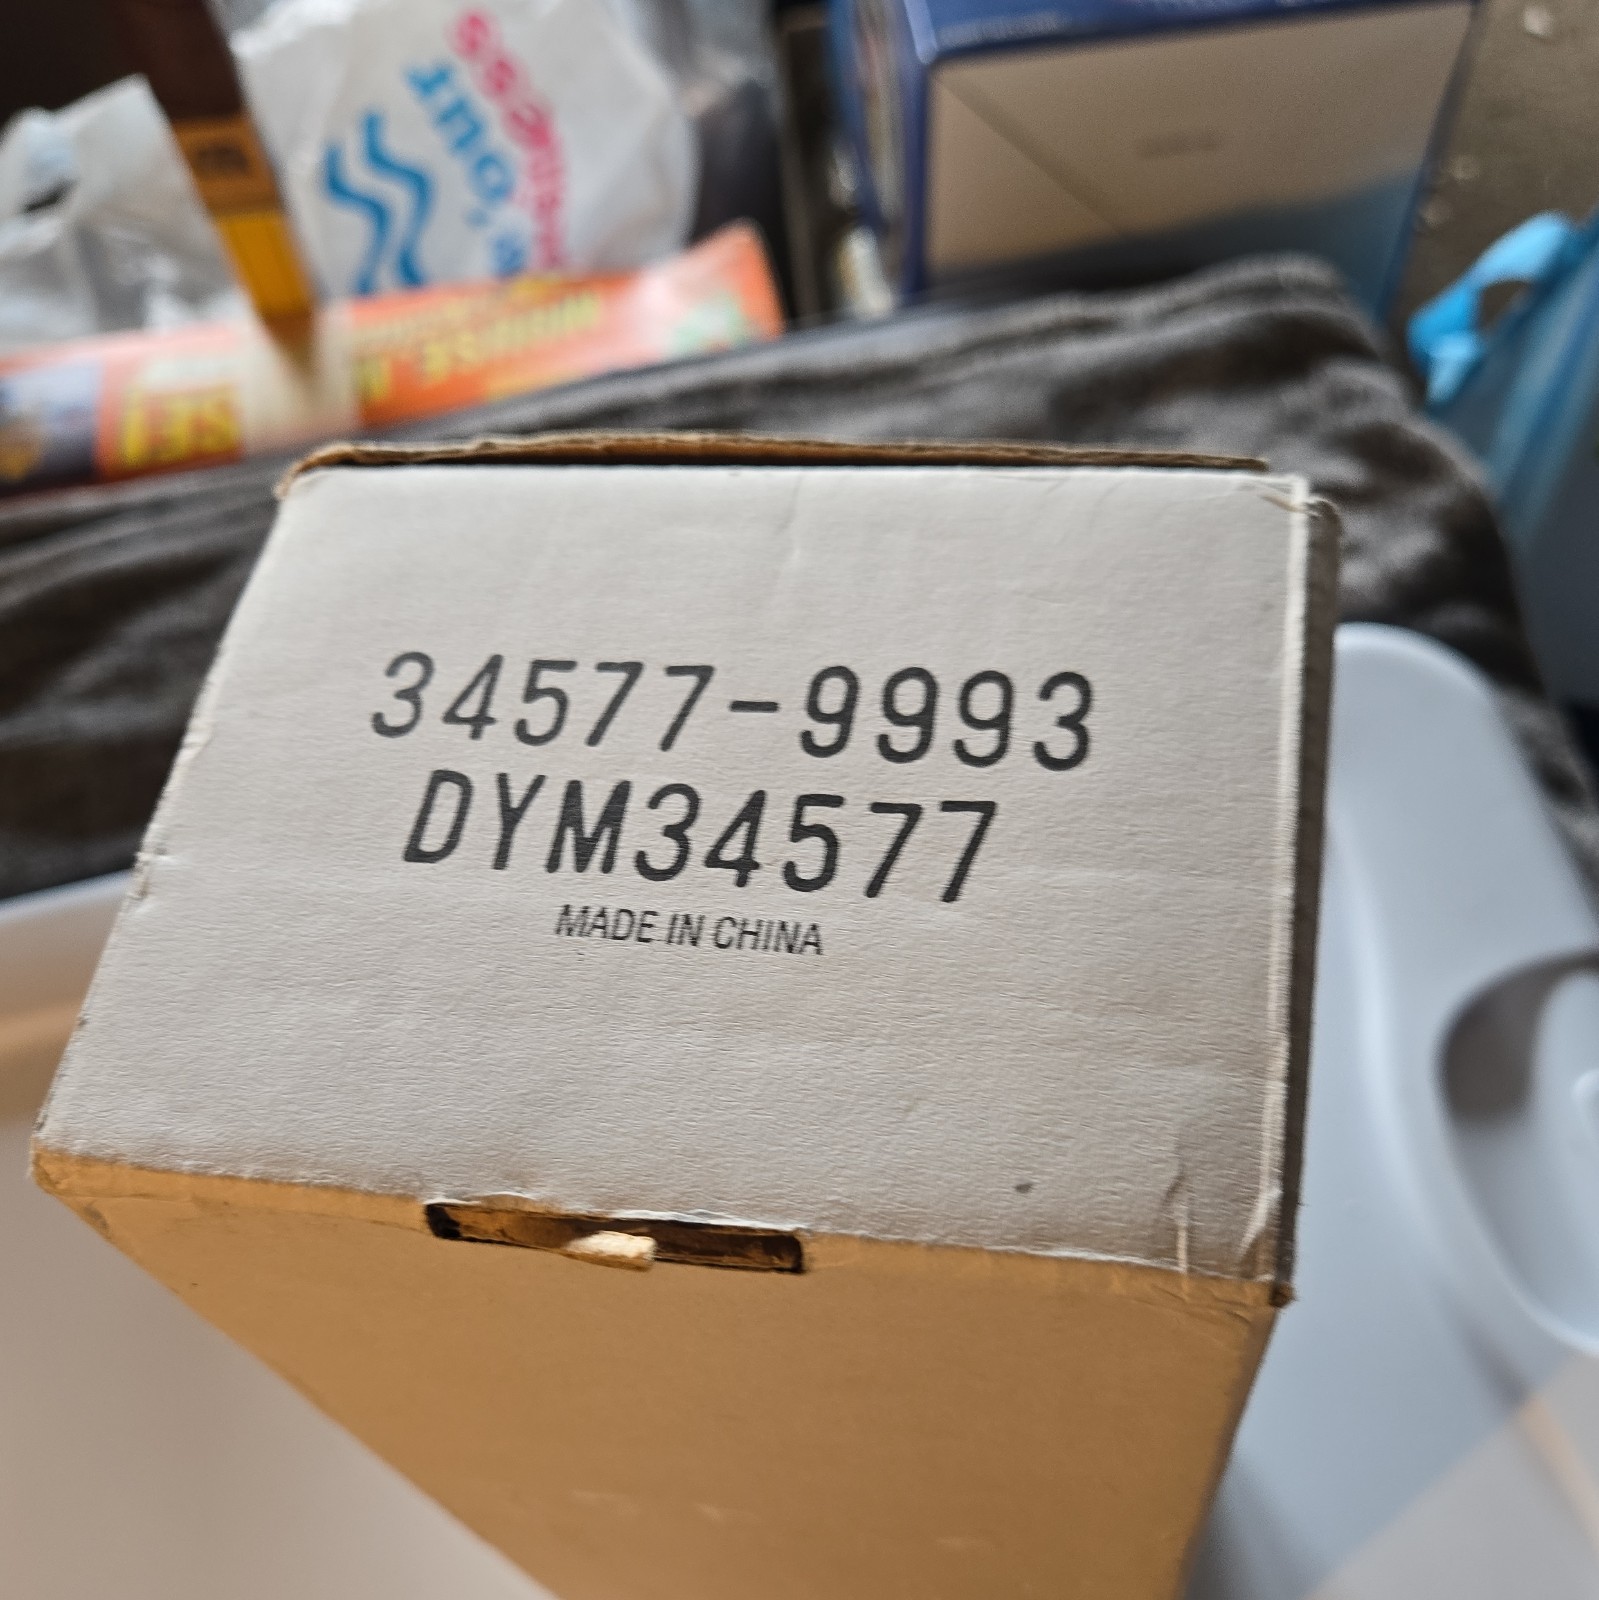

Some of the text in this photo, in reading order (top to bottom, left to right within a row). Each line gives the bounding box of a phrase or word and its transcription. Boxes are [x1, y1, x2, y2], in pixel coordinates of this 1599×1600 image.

[368, 649, 1096, 773] 34577-9993
[400, 767, 1000, 905] DYM34577
[554, 903, 825, 956] MADE IN CHINA
